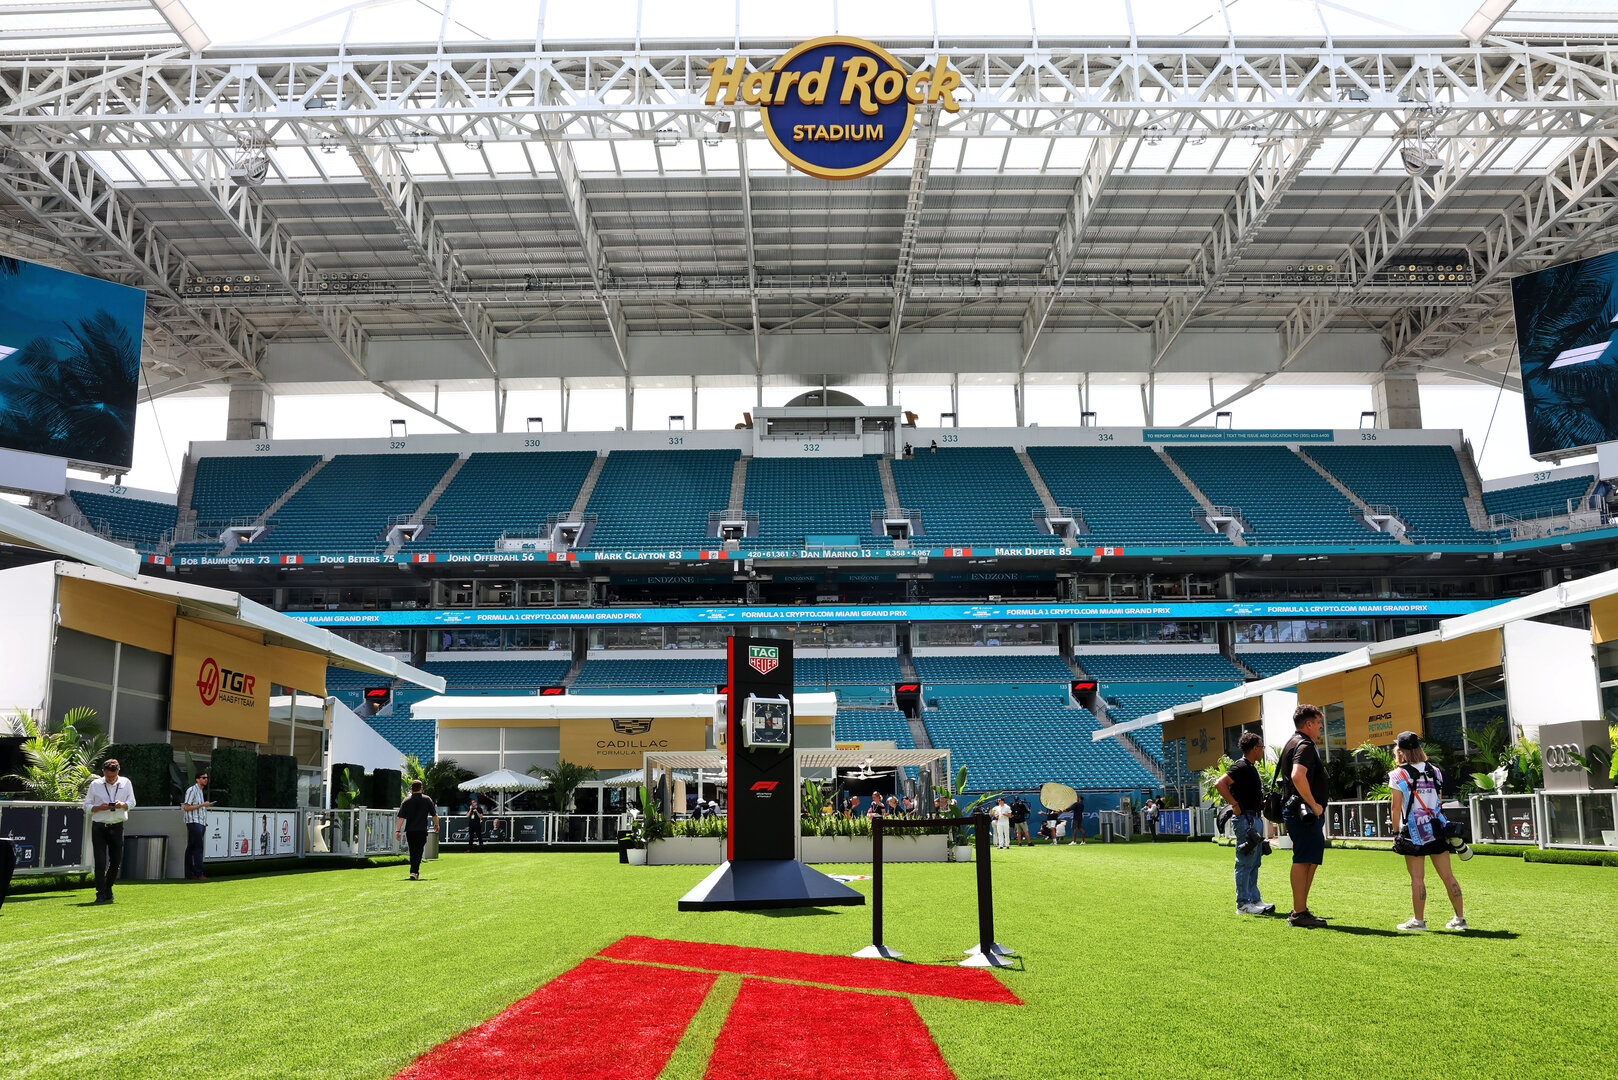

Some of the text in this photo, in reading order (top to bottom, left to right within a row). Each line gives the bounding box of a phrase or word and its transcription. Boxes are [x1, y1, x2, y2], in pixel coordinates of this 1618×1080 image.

[704, 56, 961, 115] Hard Rock
[793, 124, 884, 142] STADIUM
[668, 437, 684, 445] 331
[942, 434, 958, 443] 333
[1098, 433, 1114, 441] 334
[1361, 433, 1377, 441] 336
[390, 441, 406, 449] 329
[524, 439, 540, 447] 330
[255, 444, 271, 452] 328
[803, 444, 820, 452] 332
[1533, 471, 1552, 482] 337
[109, 485, 128, 495] 327
[861, 550, 871, 558] 13
[1059, 547, 1072, 556] 85
[383, 555, 395, 563] 75
[522, 554, 535, 562] 56
[668, 552, 682, 560] 83
[752, 647, 776, 658] TAG
[750, 658, 776, 672] HEUER
[221, 668, 255, 695] TGR
[219, 694, 234, 704] HAAS
[240, 698, 254, 708] TEAM
[1368, 720, 1392, 732] PETRONAS
[597, 740, 668, 748] CADILLAC
[1514, 826, 1518, 834] 5
